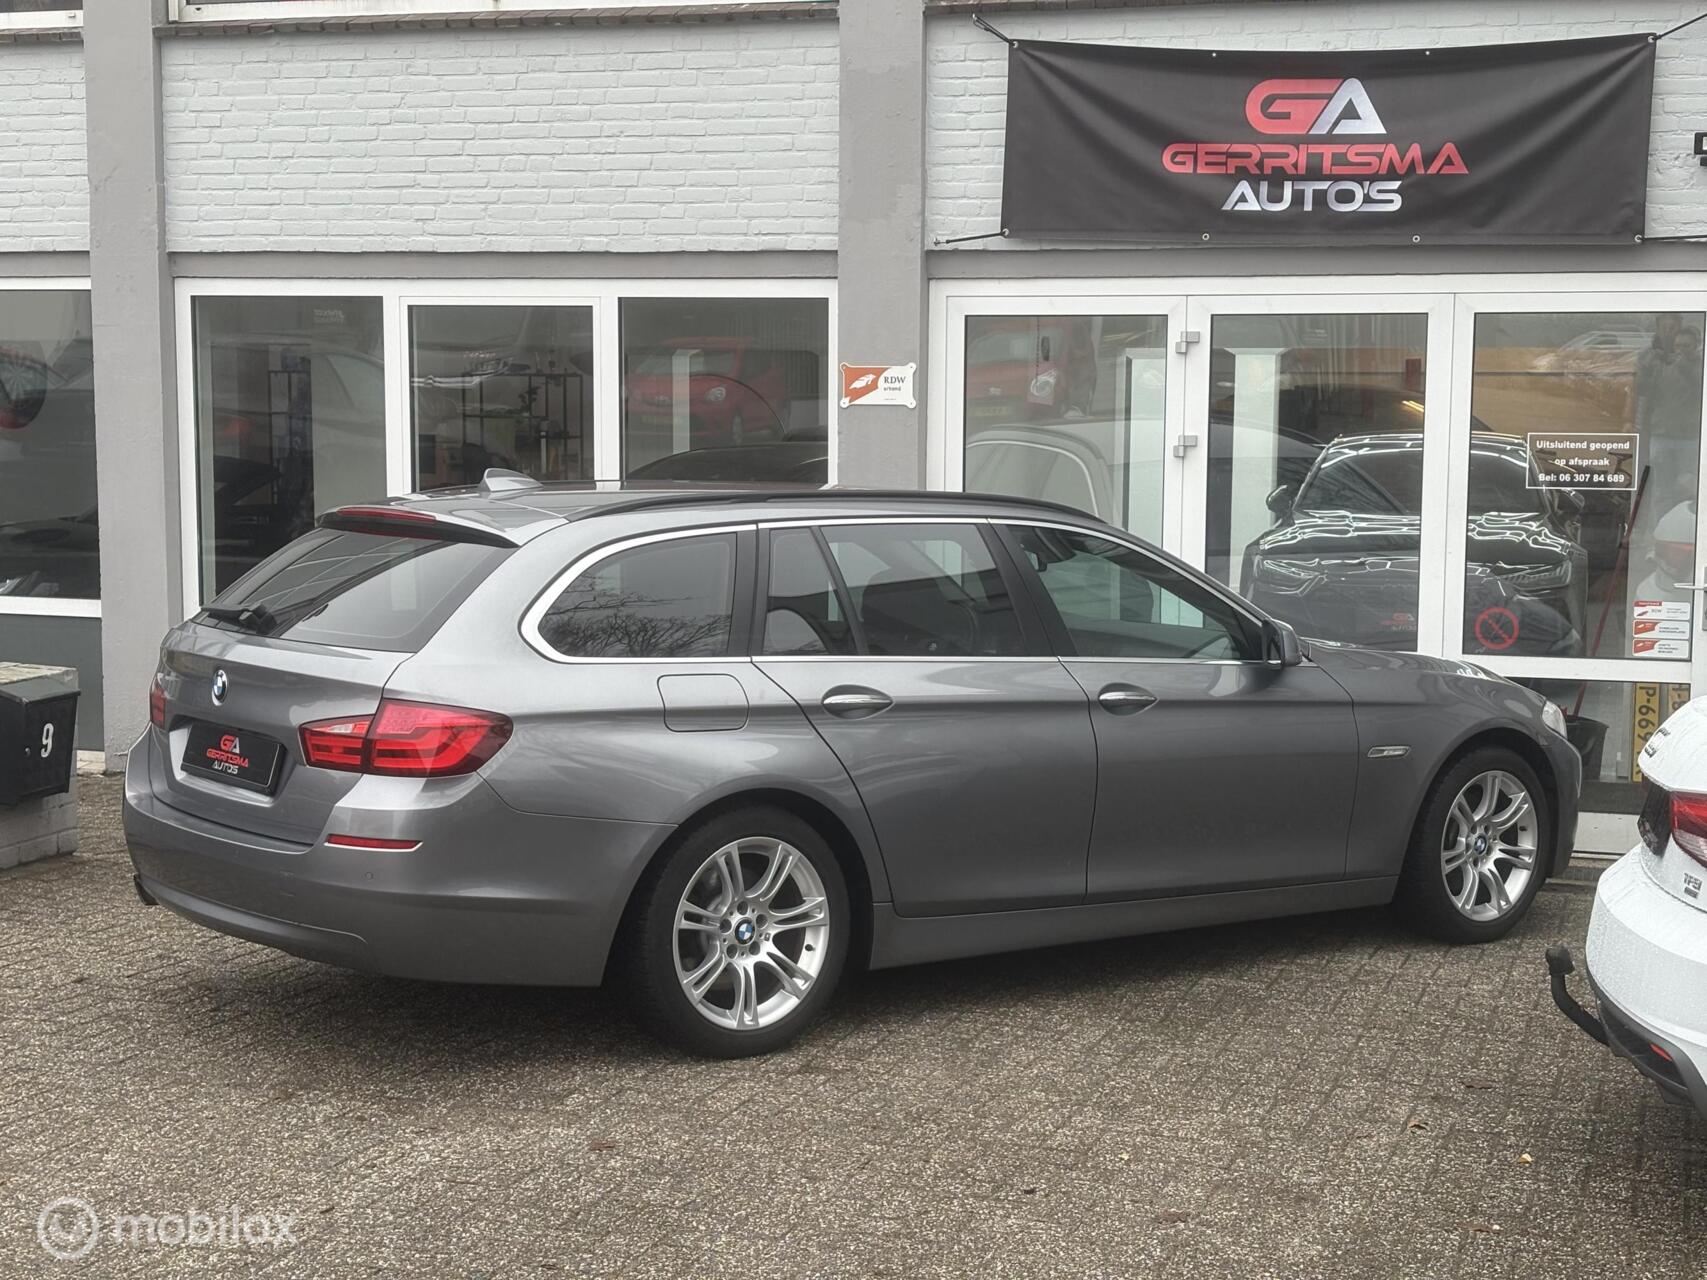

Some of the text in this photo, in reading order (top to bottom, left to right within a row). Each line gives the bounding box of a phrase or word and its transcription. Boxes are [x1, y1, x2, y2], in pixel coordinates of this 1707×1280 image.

[1245, 77, 1387, 135] GA
[1162, 142, 1470, 175] GERRITSMA
[1221, 179, 1403, 212] AUTO'S
[883, 376, 906, 384] RDW
[1536, 440, 1630, 451] Uitsluitend geopend
[1554, 457, 1610, 468] op afspraak
[1538, 473, 1625, 483] Bel: 06 307 84 689
[41, 722, 54, 758] 9
